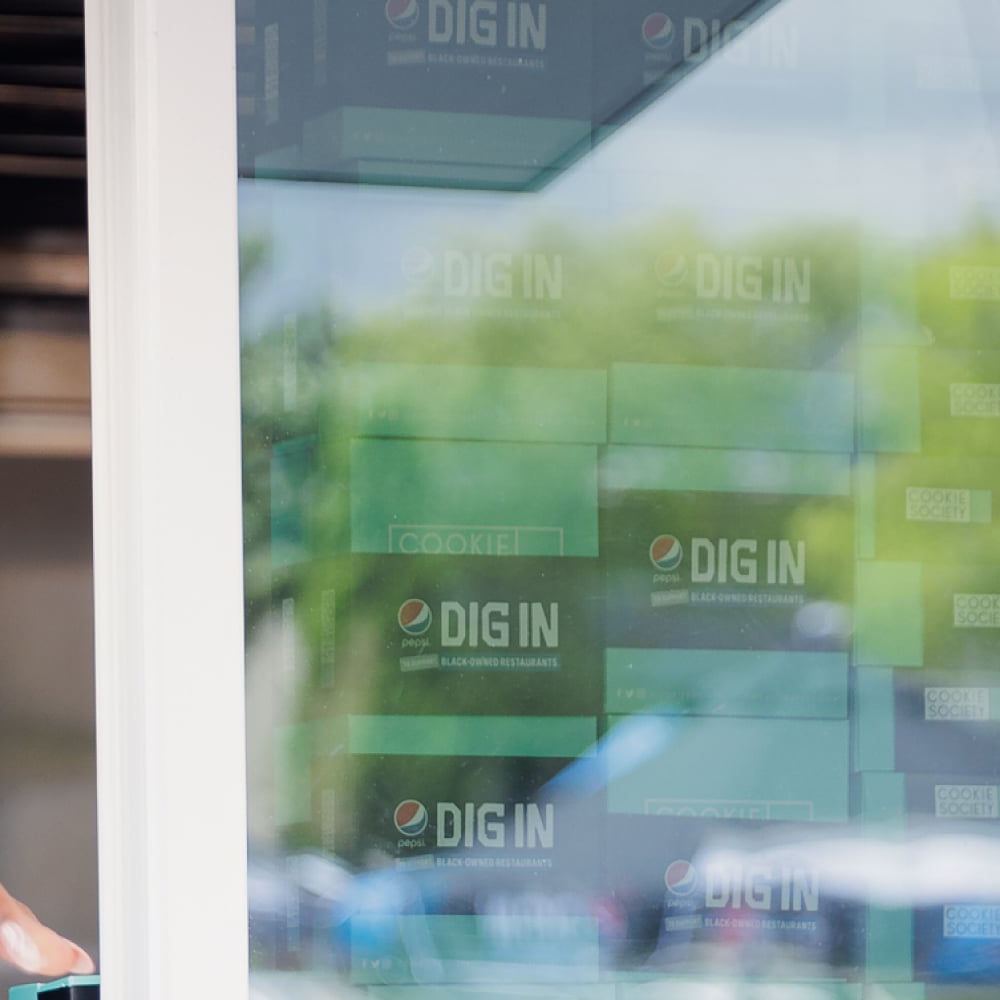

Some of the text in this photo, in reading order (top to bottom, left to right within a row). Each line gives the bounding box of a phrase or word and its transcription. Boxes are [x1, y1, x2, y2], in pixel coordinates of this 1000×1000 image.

[427, 0, 548, 51] DIG IN
[443, 251, 563, 300] DIG IN
[696, 252, 811, 304] DIG IN
[908, 488, 968, 505] COOKIE
[909, 504, 968, 519] SOCIETY
[399, 531, 512, 556] COOKIE
[691, 537, 806, 585] DIG IN
[440, 601, 560, 649] DIG IN
[441, 657, 499, 667] BLACK-OWNED
[500, 656, 558, 668] RESTAURANTS
[937, 787, 993, 801] COOKIE
[938, 802, 994, 816] SOCIETY
[436, 801, 555, 849] DIG IN
[704, 860, 819, 911] DIG IN
